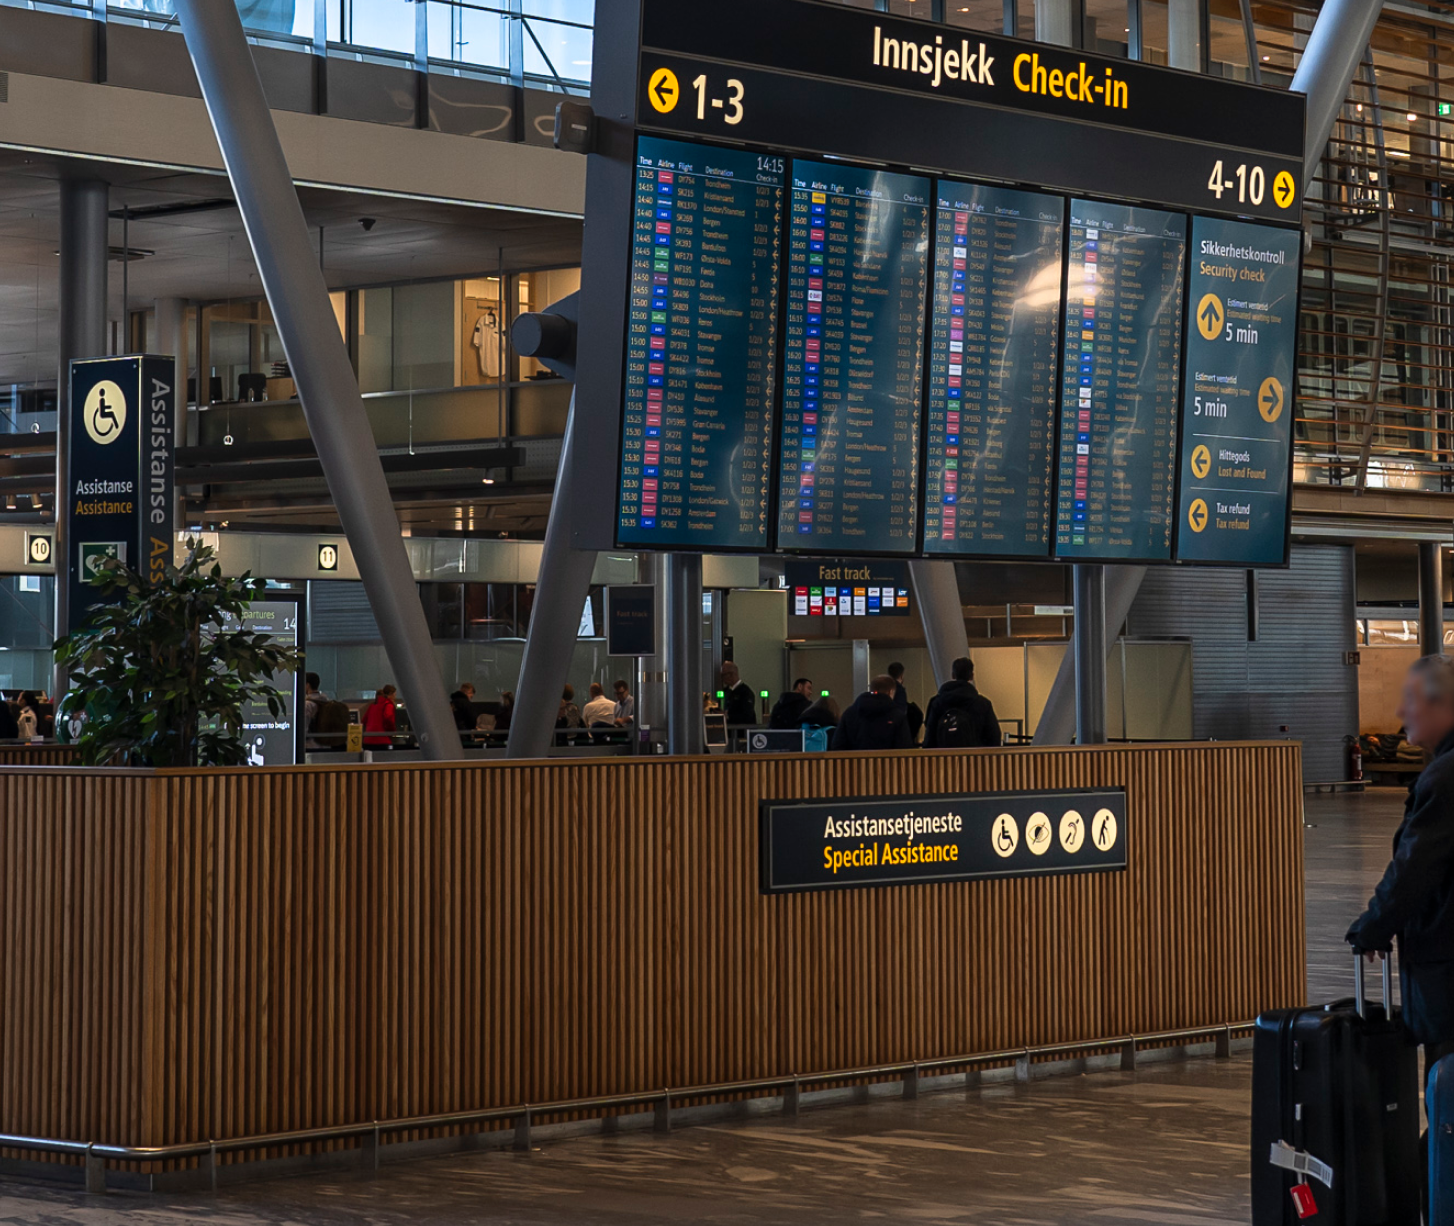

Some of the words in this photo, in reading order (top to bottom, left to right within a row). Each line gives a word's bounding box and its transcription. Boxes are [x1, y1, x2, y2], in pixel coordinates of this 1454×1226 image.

[873, 26, 995, 88] Innsjekk
[1012, 53, 1129, 109] Check-in
[692, 75, 745, 125] 1-3
[639, 156, 652, 166] Time
[658, 159, 675, 169] Airline
[679, 162, 693, 172] Flight
[705, 166, 733, 177] Destination
[756, 173, 778, 183] Check-in
[757, 156, 784, 174] 14:15
[794, 178, 806, 188] Time
[811, 181, 827, 191] Airline
[830, 183, 844, 193] Flight
[904, 193, 924, 203] Check-in
[1208, 160, 1265, 206] 4-10
[1201, 240, 1284, 265] Sikkerhetskontroll
[1200, 261, 1238, 282] Security
[1239, 268, 1265, 282] check
[1228, 298, 1247, 309] Estimert
[1227, 309, 1251, 320] Estimated
[1225, 322, 1233, 342] 5
[1236, 324, 1258, 344] min
[1195, 372, 1216, 382] Estimert
[1194, 383, 1219, 393] Estimated
[1194, 397, 1201, 415] 5
[1205, 398, 1227, 418] min
[150, 377, 172, 525] Assistanse
[1219, 449, 1250, 464] Hittegods
[1218, 466, 1232, 477] Lost
[1234, 468, 1245, 478] and
[1247, 468, 1266, 479] Found
[76, 479, 133, 496] Assistanse
[75, 500, 133, 516] Assistance
[1216, 502, 1228, 513] Tax
[1229, 503, 1250, 515] refund
[1216, 518, 1227, 529] Tax
[1228, 519, 1250, 530] refund
[34, 542, 47, 555] 10
[322, 551, 334, 563] 11
[819, 566, 841, 580] Fast
[844, 566, 870, 580] track
[824, 812, 962, 840] Assistansetjeneste
[823, 842, 878, 874] Special
[881, 841, 959, 866] Assistance
